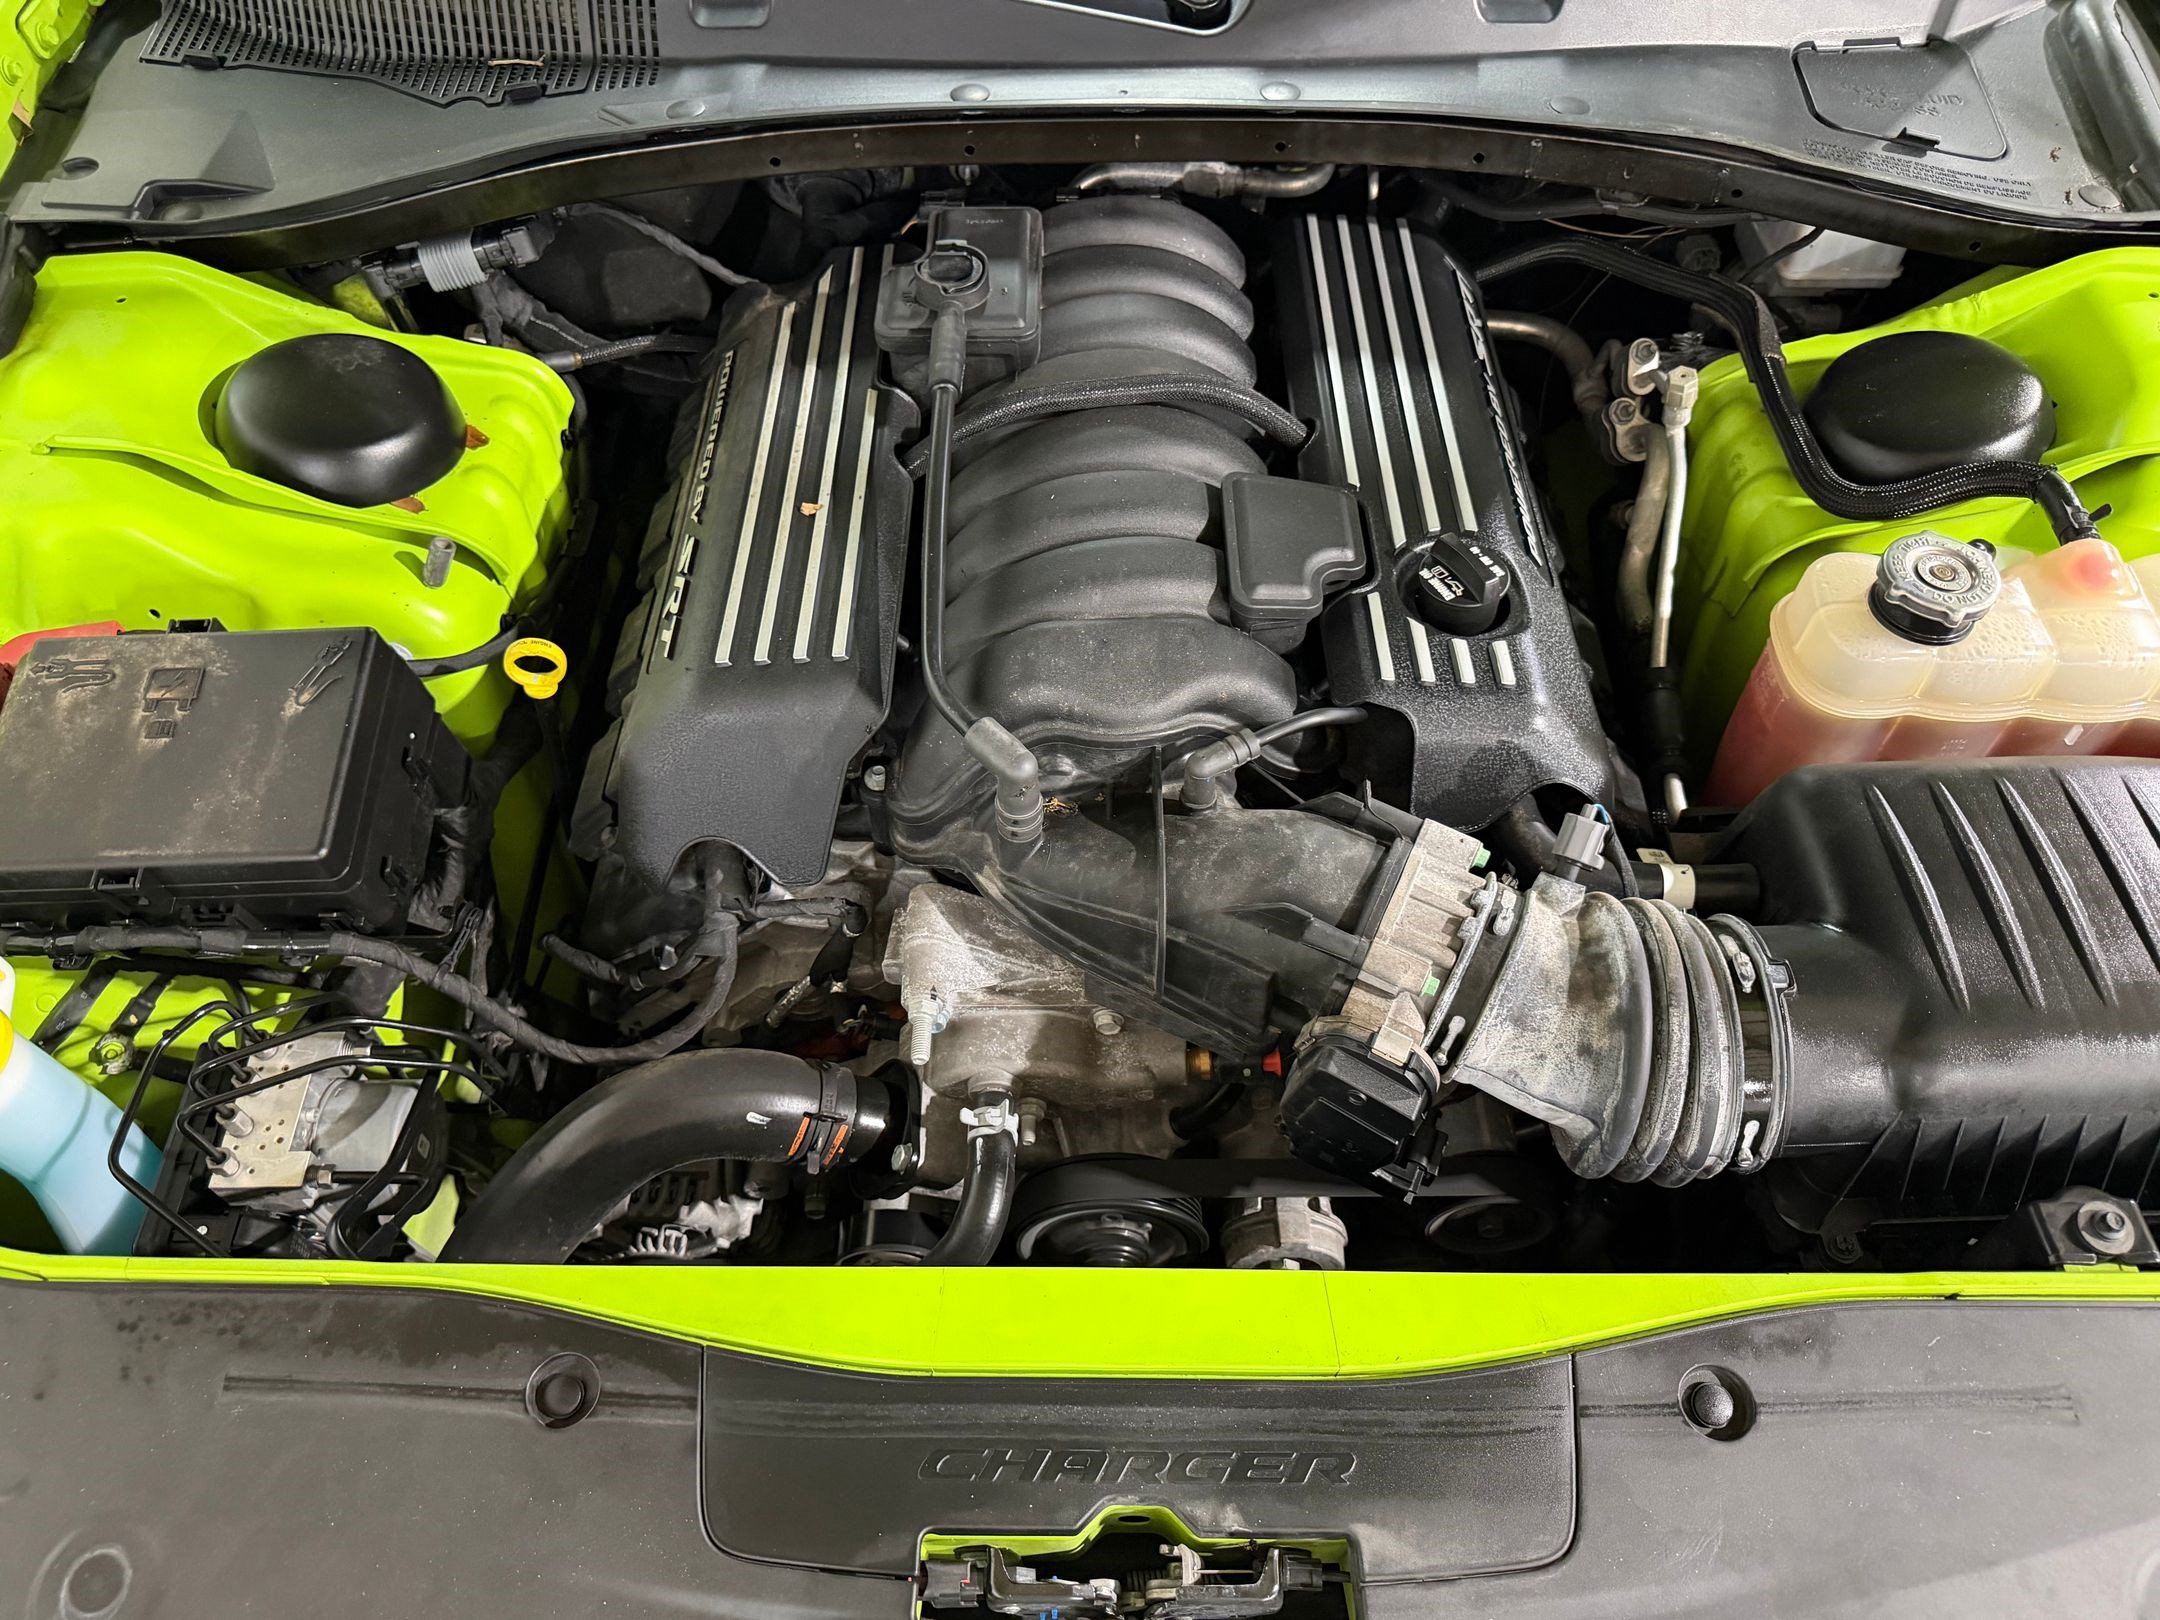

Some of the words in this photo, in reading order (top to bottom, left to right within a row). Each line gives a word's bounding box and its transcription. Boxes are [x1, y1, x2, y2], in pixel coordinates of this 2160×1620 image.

[1914, 161, 1945, 172] BEFORE
[700, 350, 734, 482] POWERED
[689, 484, 706, 525] BY
[661, 533, 695, 659] SRT
[1932, 592, 1953, 603] DO
[917, 1447, 1358, 1486] CHARGER
